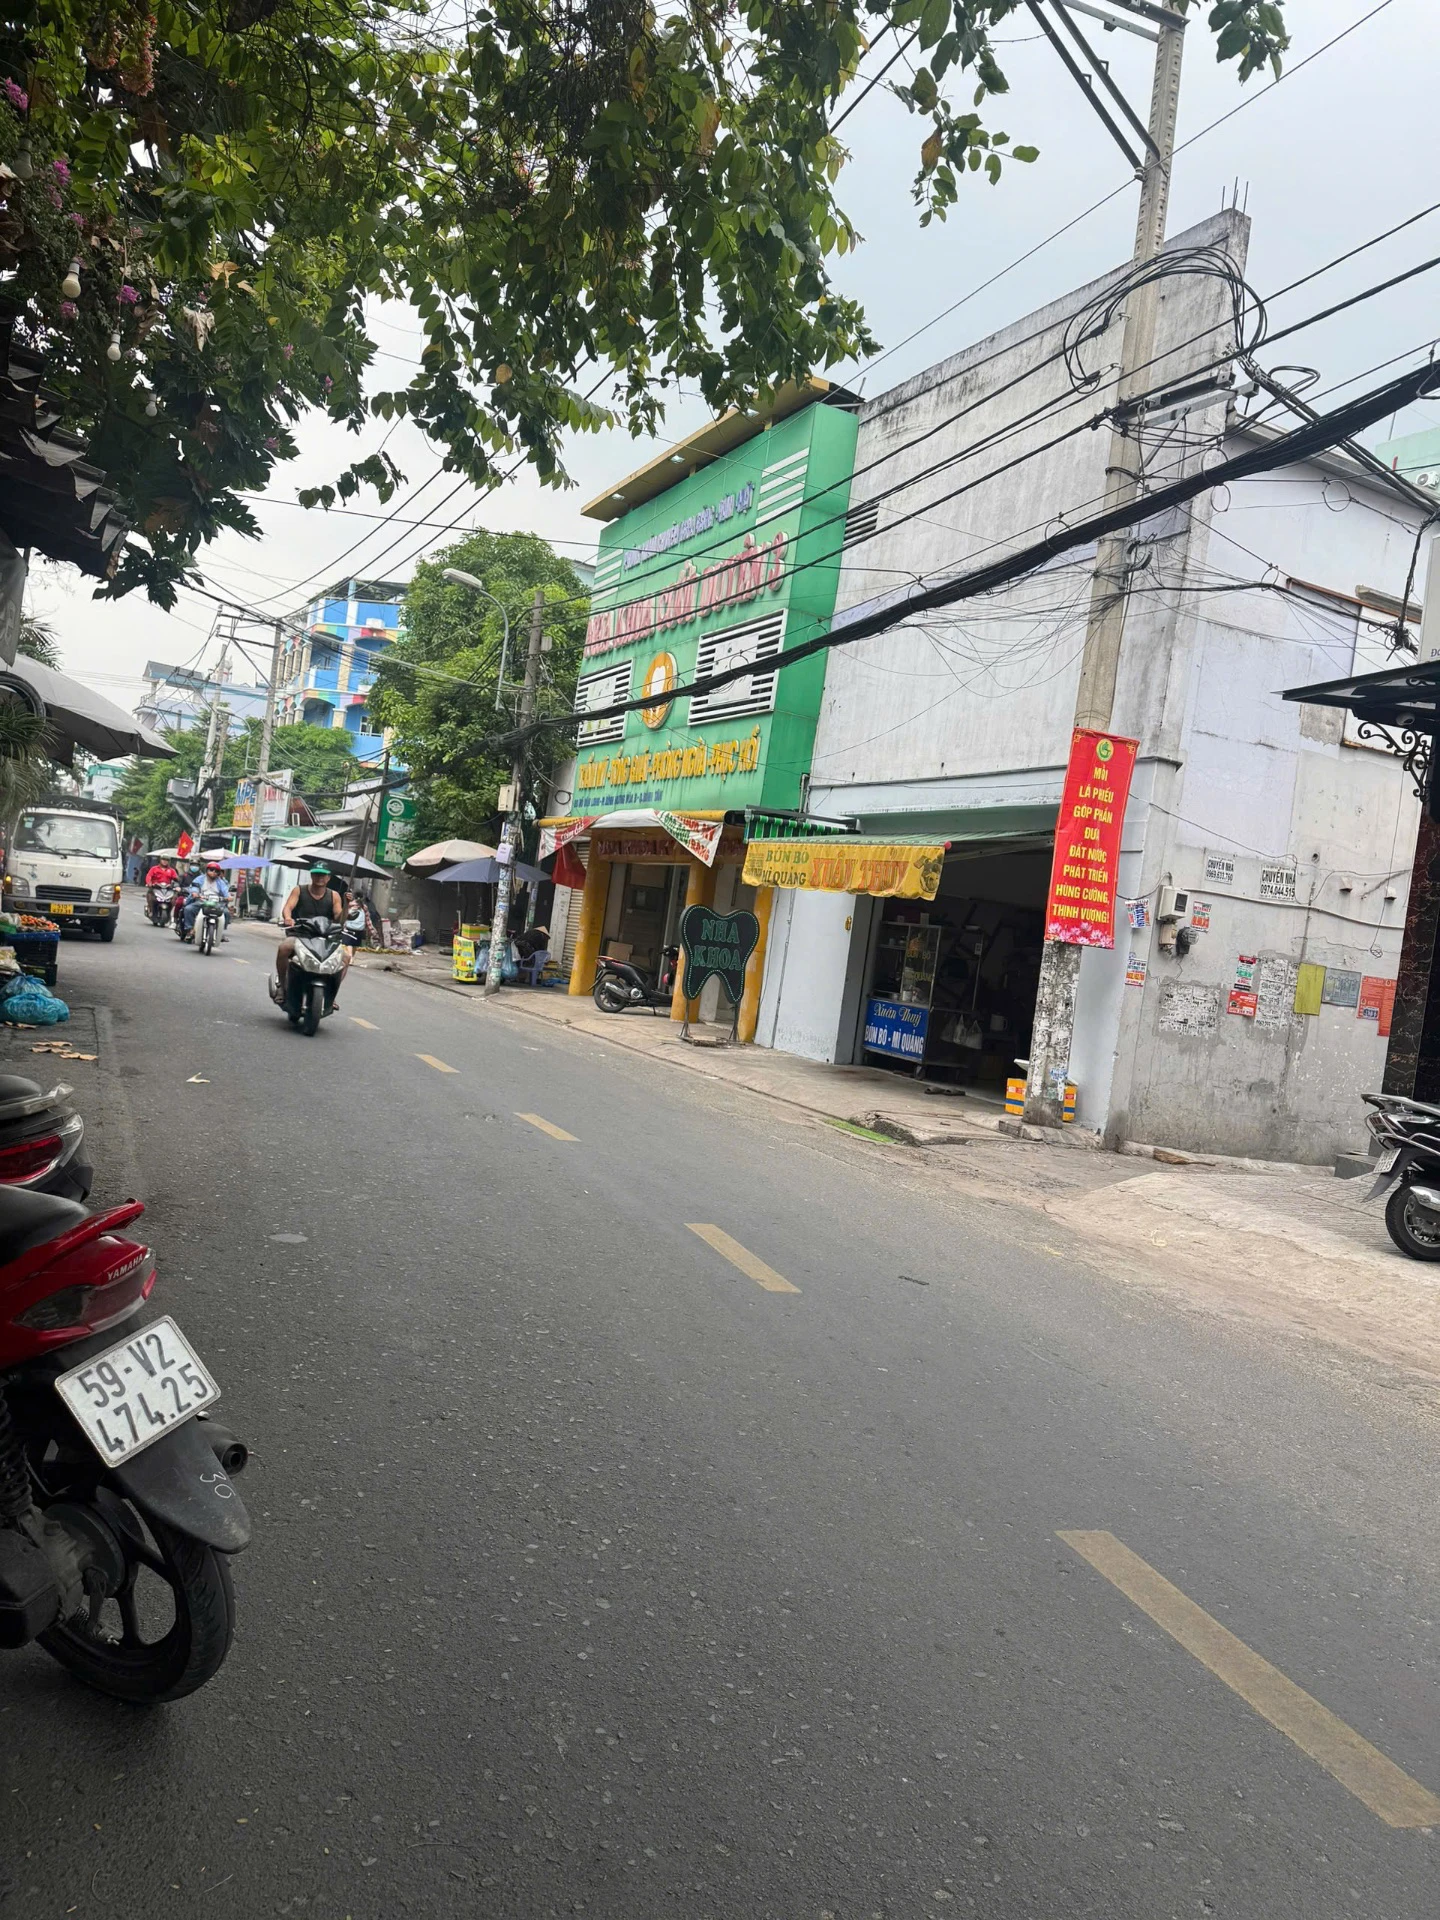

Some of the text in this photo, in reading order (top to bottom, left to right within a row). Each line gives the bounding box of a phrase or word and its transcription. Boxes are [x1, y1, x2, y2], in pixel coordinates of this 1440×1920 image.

[1079, 784, 1091, 798] LÁ
[1073, 804, 1092, 818] GÓP
[1069, 842, 1087, 858] ĐẤT
[1063, 863, 1087, 879] PHÁT
[1055, 883, 1081, 898] HÙNG
[1052, 904, 1079, 919] THỊNH
[701, 918, 740, 944] NHA
[693, 945, 742, 971] KHOA
[874, 1001, 897, 1019] Xuân
[864, 1022, 878, 1043] BÚN
[877, 1025, 888, 1046] BÒ
[891, 1028, 902, 1049] MÌ
[901, 1029, 925, 1054] QUẢNG
[107, 1253, 143, 1281] YAMAHA
[77, 1334, 175, 1407] 59-V2
[97, 1363, 208, 1452] 474.25
